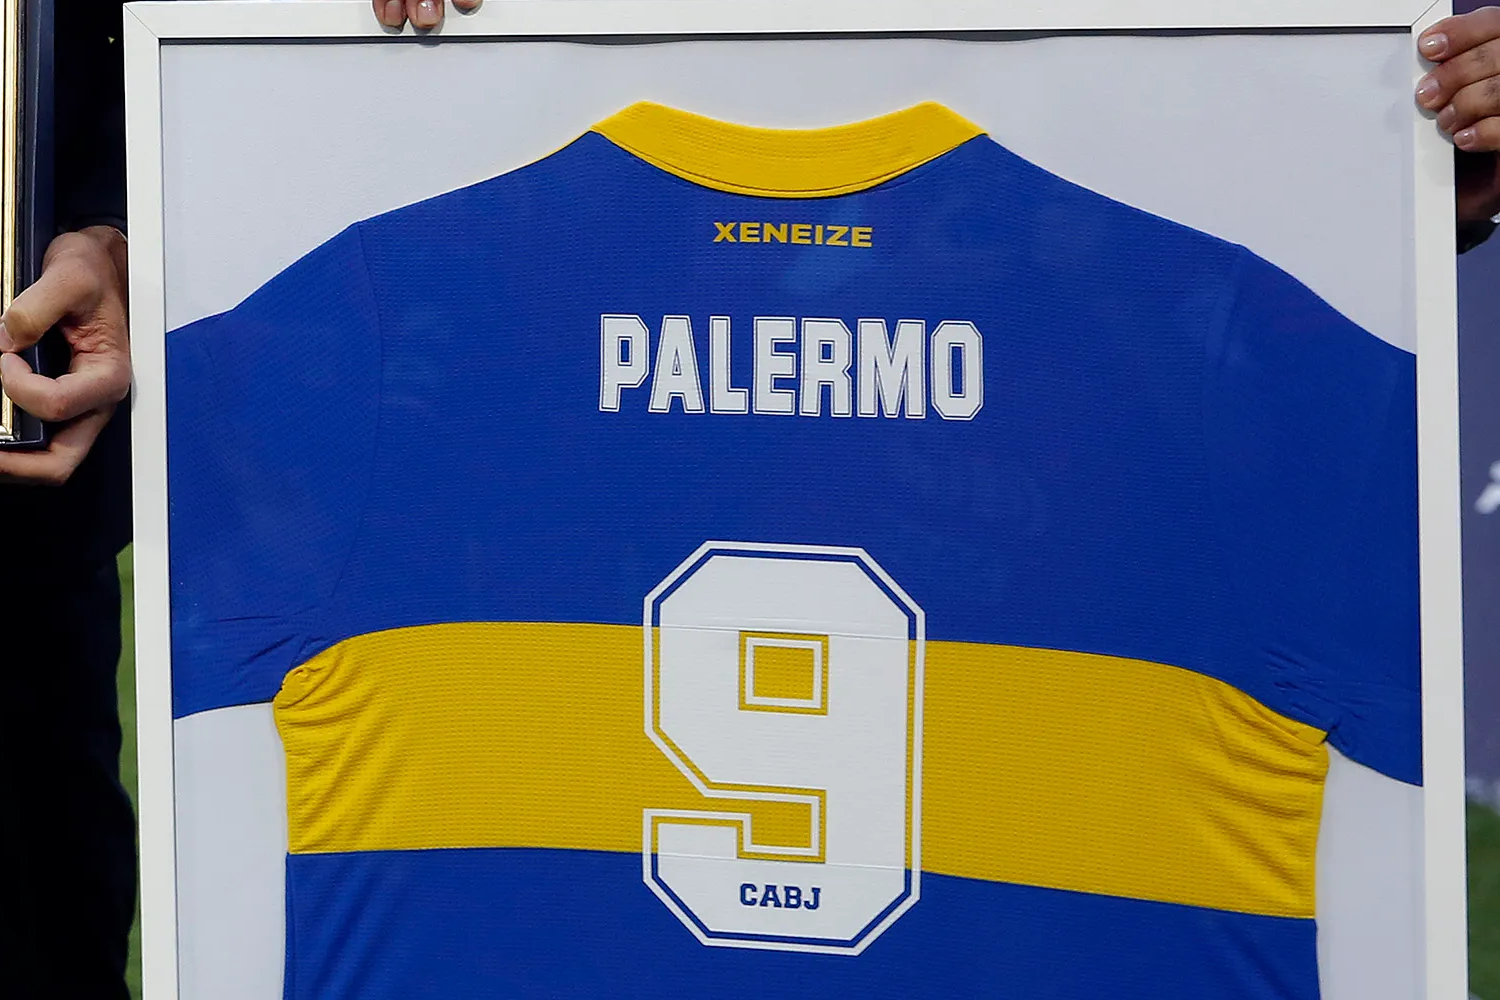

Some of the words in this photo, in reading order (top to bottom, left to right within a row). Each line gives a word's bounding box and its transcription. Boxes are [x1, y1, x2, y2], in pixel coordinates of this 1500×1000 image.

[712, 221, 874, 248] XENEIZE
[598, 313, 985, 421] PALERMO
[642, 540, 926, 957] 9
[739, 882, 823, 911] CABJ
